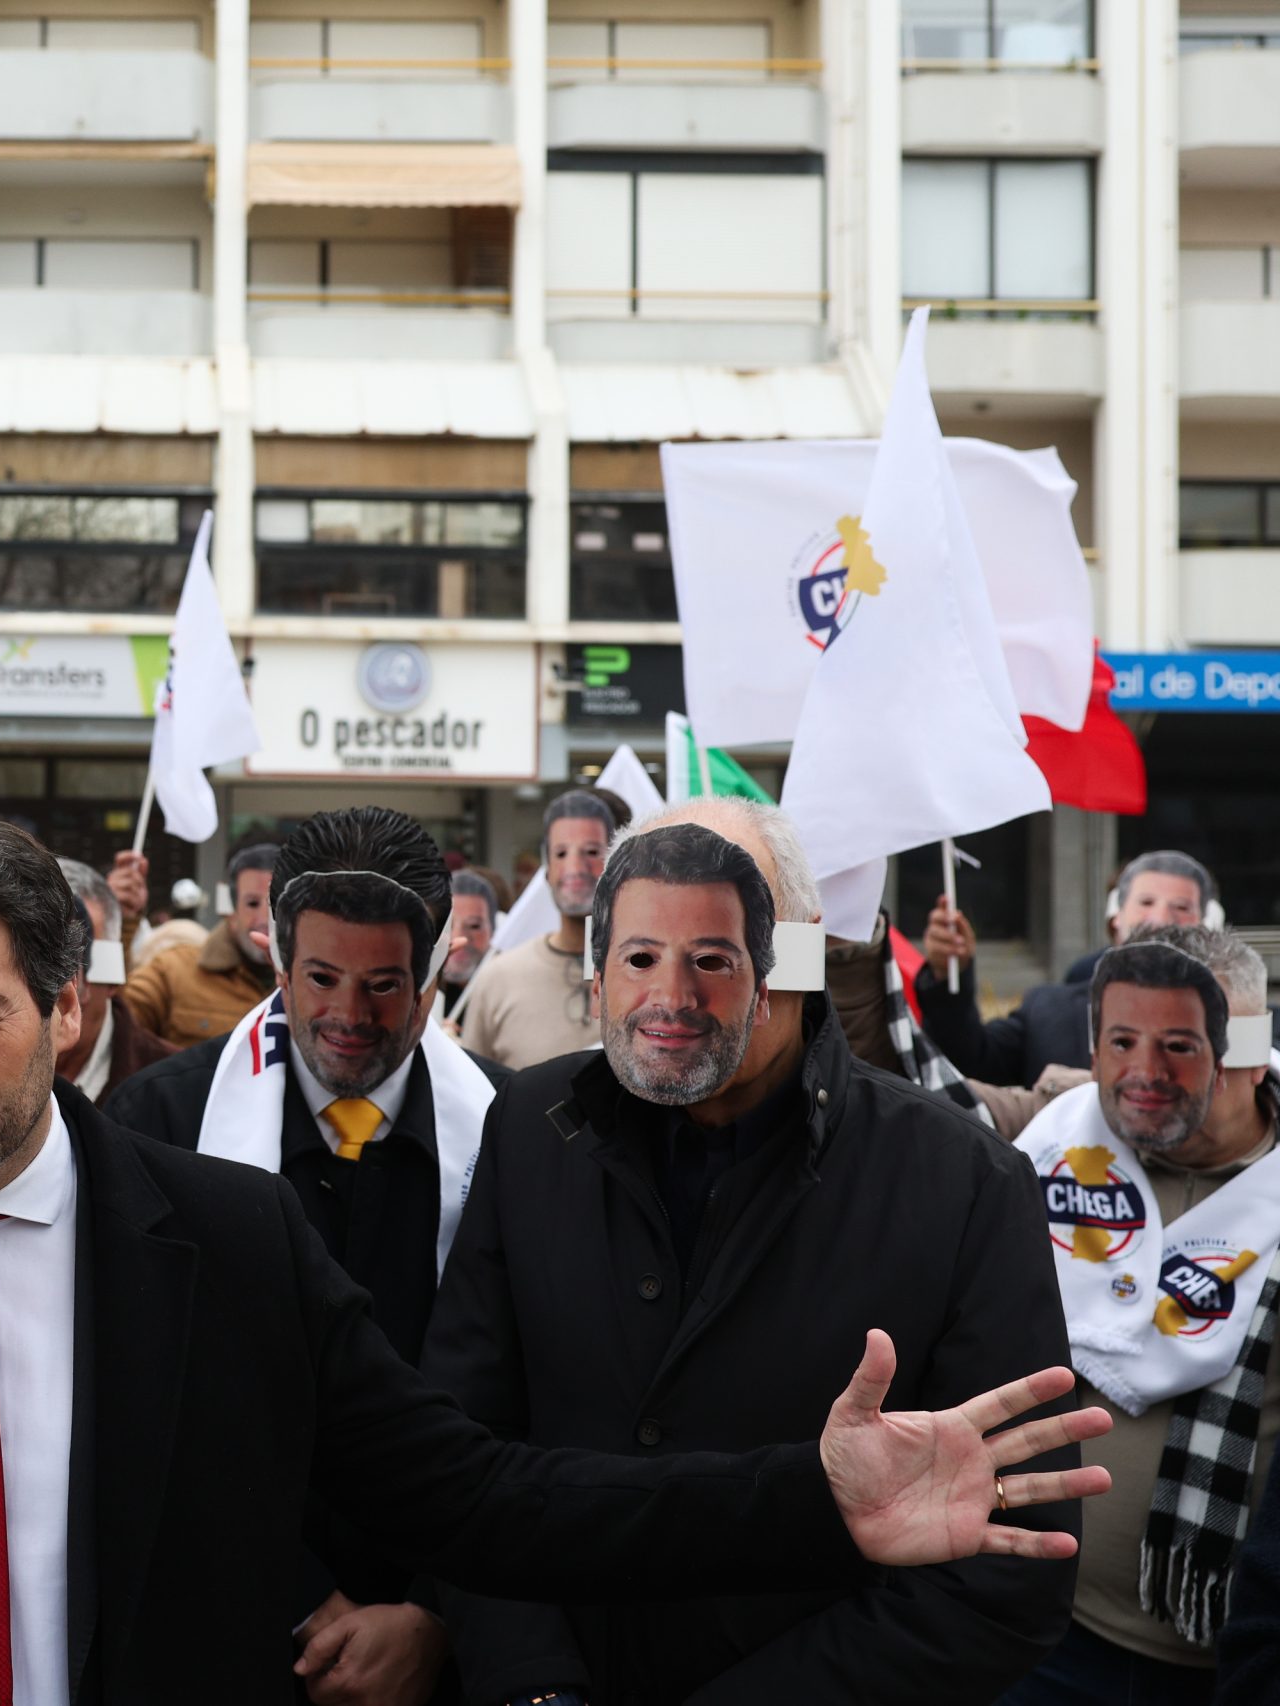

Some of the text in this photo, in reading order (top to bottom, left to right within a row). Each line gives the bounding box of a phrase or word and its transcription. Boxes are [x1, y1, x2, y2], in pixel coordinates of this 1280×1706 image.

[1150, 664, 1197, 699] de
[300, 709, 483, 756] O pescador
[1046, 1182, 1135, 1220] CHEGA
